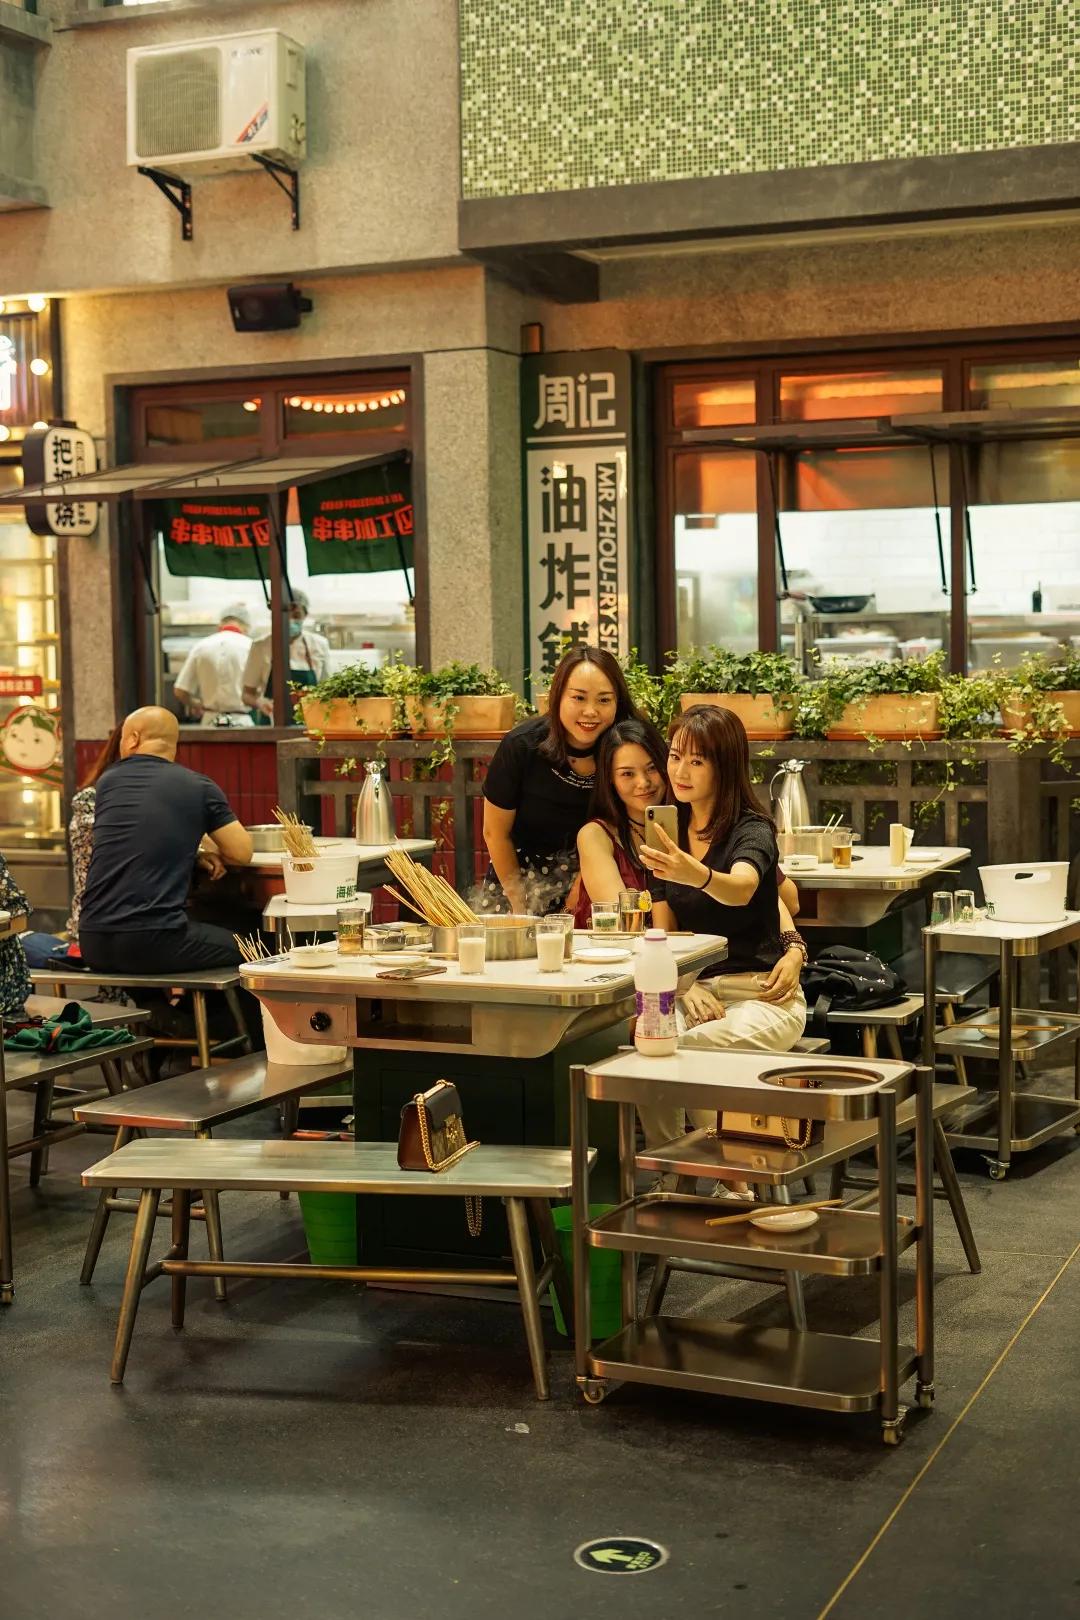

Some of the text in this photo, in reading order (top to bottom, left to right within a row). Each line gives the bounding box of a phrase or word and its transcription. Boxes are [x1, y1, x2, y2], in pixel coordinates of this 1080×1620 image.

[533, 372, 616, 430] 周记
[598, 465, 619, 656] MR ZHOU-FRY SH
